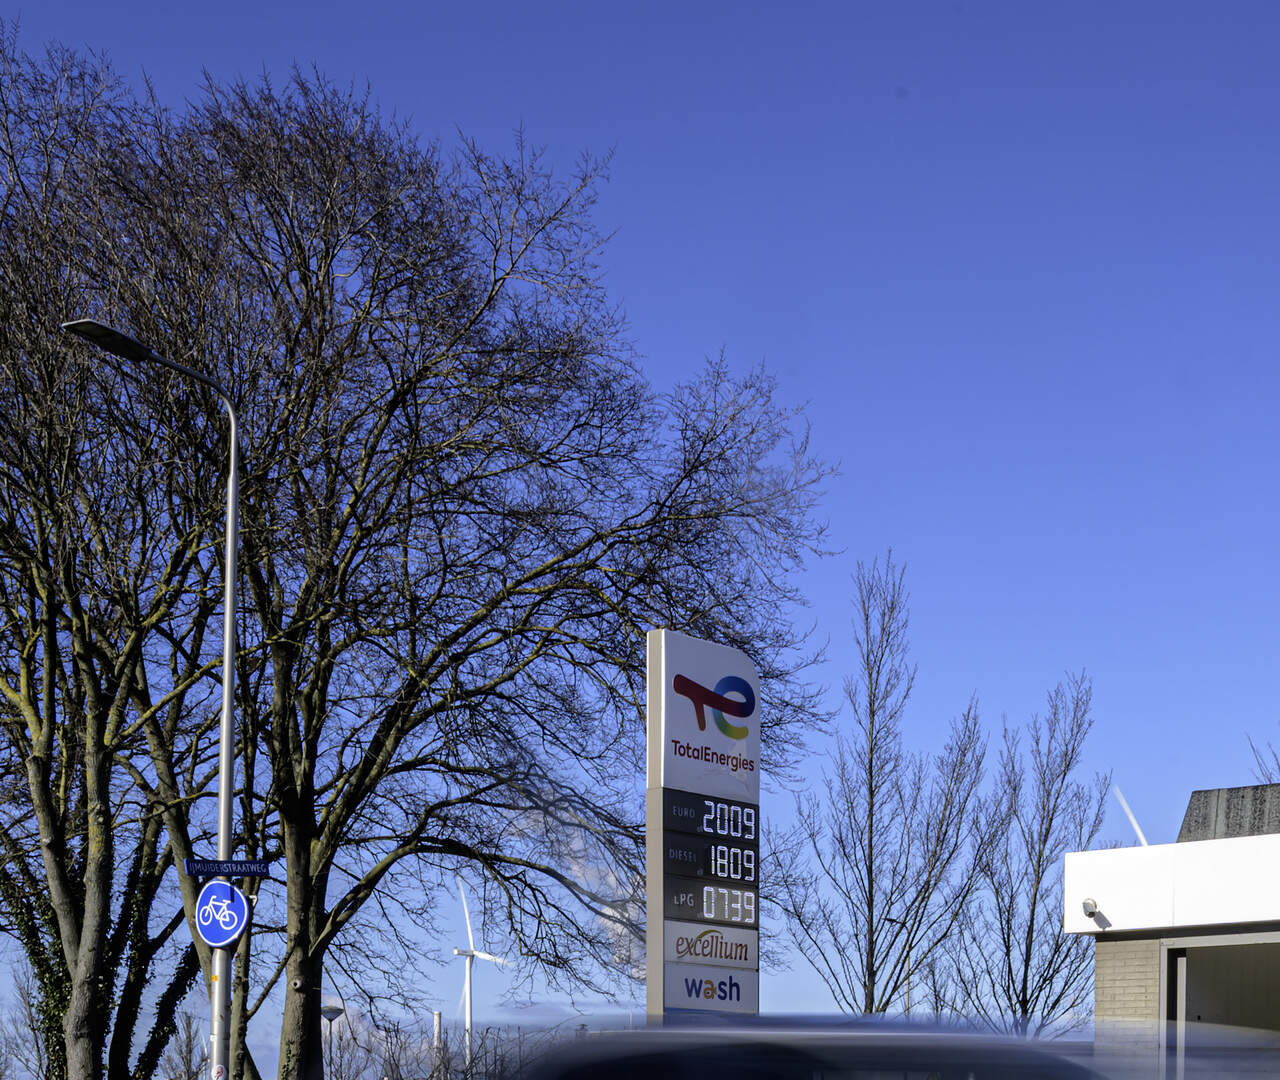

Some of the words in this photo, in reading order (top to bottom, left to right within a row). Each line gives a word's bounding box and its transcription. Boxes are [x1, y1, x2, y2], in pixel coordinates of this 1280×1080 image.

[672, 739, 755, 772] TotalEnergies
[672, 805, 696, 818] EURO
[703, 800, 755, 840] 2009
[711, 844, 755, 882] 1809
[674, 893, 695, 908] LPG
[703, 885, 756, 923] 0739
[676, 934, 749, 961] excellium
[684, 975, 741, 1002] wash
